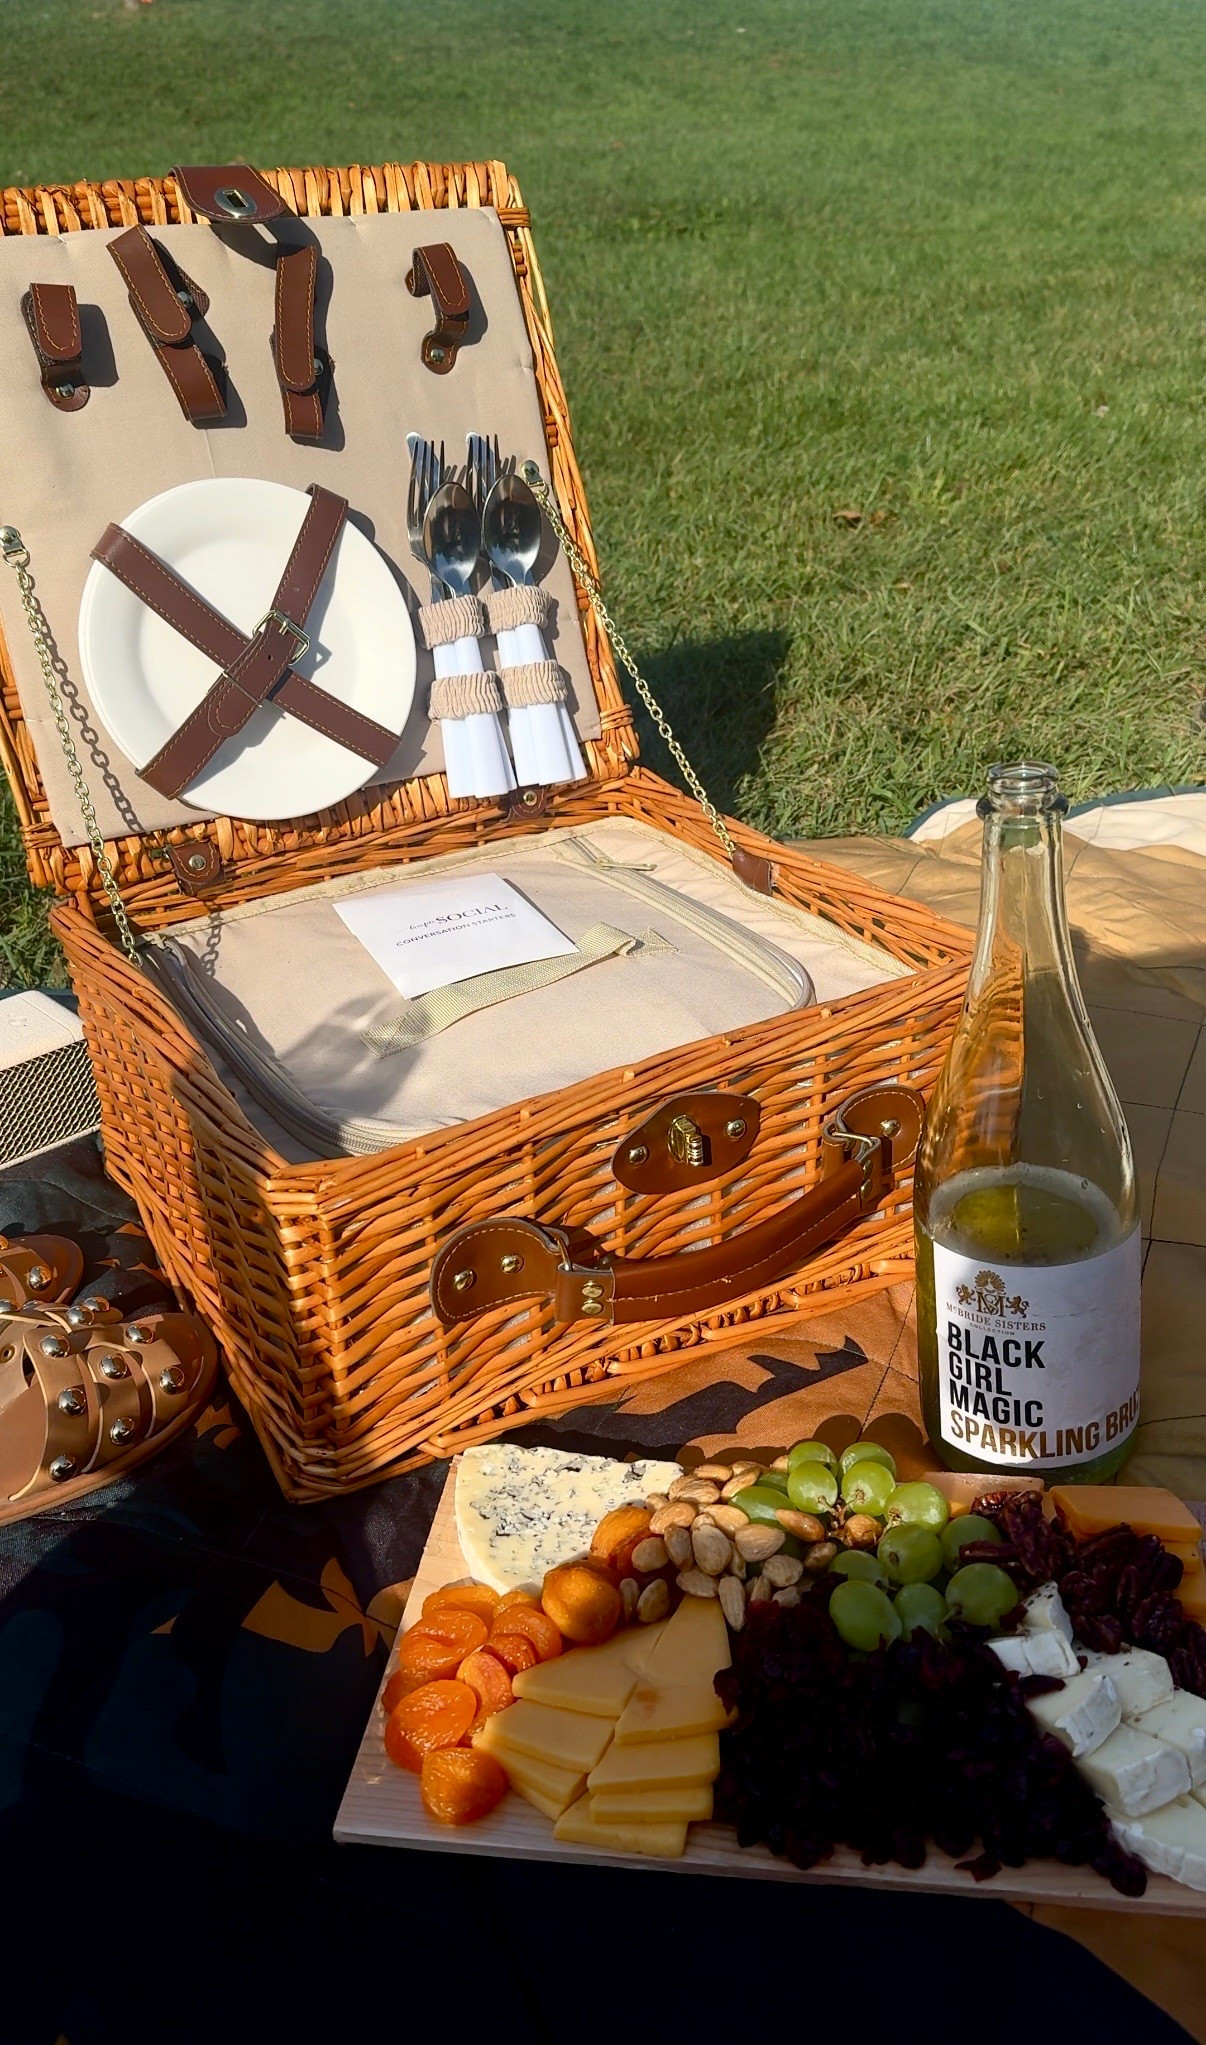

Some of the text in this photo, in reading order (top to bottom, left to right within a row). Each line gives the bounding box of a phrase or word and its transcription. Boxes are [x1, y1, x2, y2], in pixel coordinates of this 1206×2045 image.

[396, 923, 470, 946] CONVERSATION
[472, 913, 516, 926] STARTERS
[436, 904, 508, 924] SOCIAL
[948, 1321, 1045, 1368] BLACK
[969, 1322, 1015, 1335] COLLECTION
[995, 1319, 1046, 1331] SISTERS
[949, 1352, 1012, 1397] GIRL
[950, 1379, 1043, 1427] MAGIC
[951, 1411, 1099, 1459] SPARKLING
